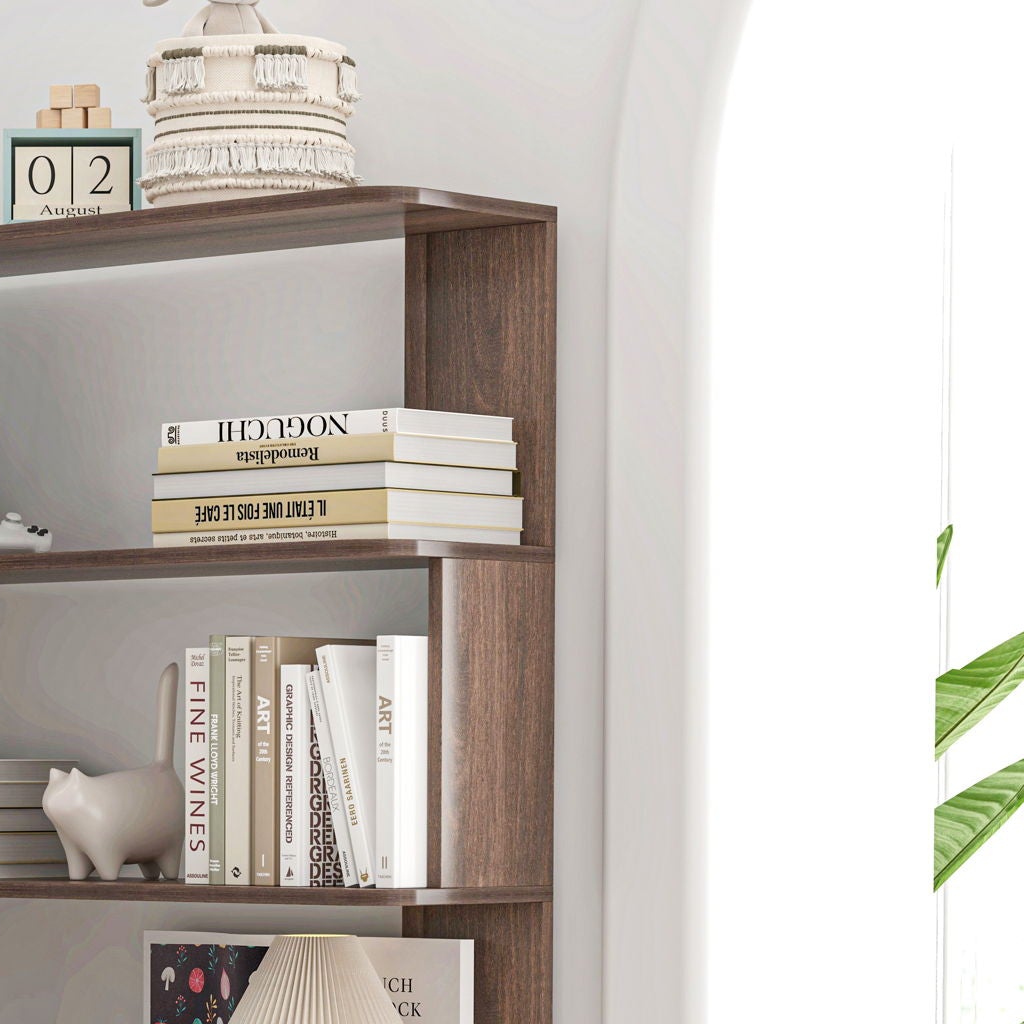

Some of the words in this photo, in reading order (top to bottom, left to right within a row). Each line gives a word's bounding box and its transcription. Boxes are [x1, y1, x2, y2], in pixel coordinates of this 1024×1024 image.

[40, 205, 103, 217] August
[218, 413, 348, 442] NOGUCHI
[236, 447, 319, 465] Remodelista
[195, 505, 221, 526] CAFÉ
[223, 504, 235, 521] LE
[238, 502, 259, 520] FOIS
[263, 502, 283, 519] UNE
[286, 500, 314, 521] ÉTAIT
[317, 499, 327, 516] IL
[217, 534, 238, 543] petits
[265, 531, 304, 541] botanique,
[306, 530, 337, 538] Histoire,
[190, 681, 205, 743] FINE
[257, 695, 270, 735] ART
[379, 695, 392, 735] ART
[339, 757, 354, 801] SAARINEN
[190, 757, 206, 852] WINES
[348, 803, 358, 826] EERO
